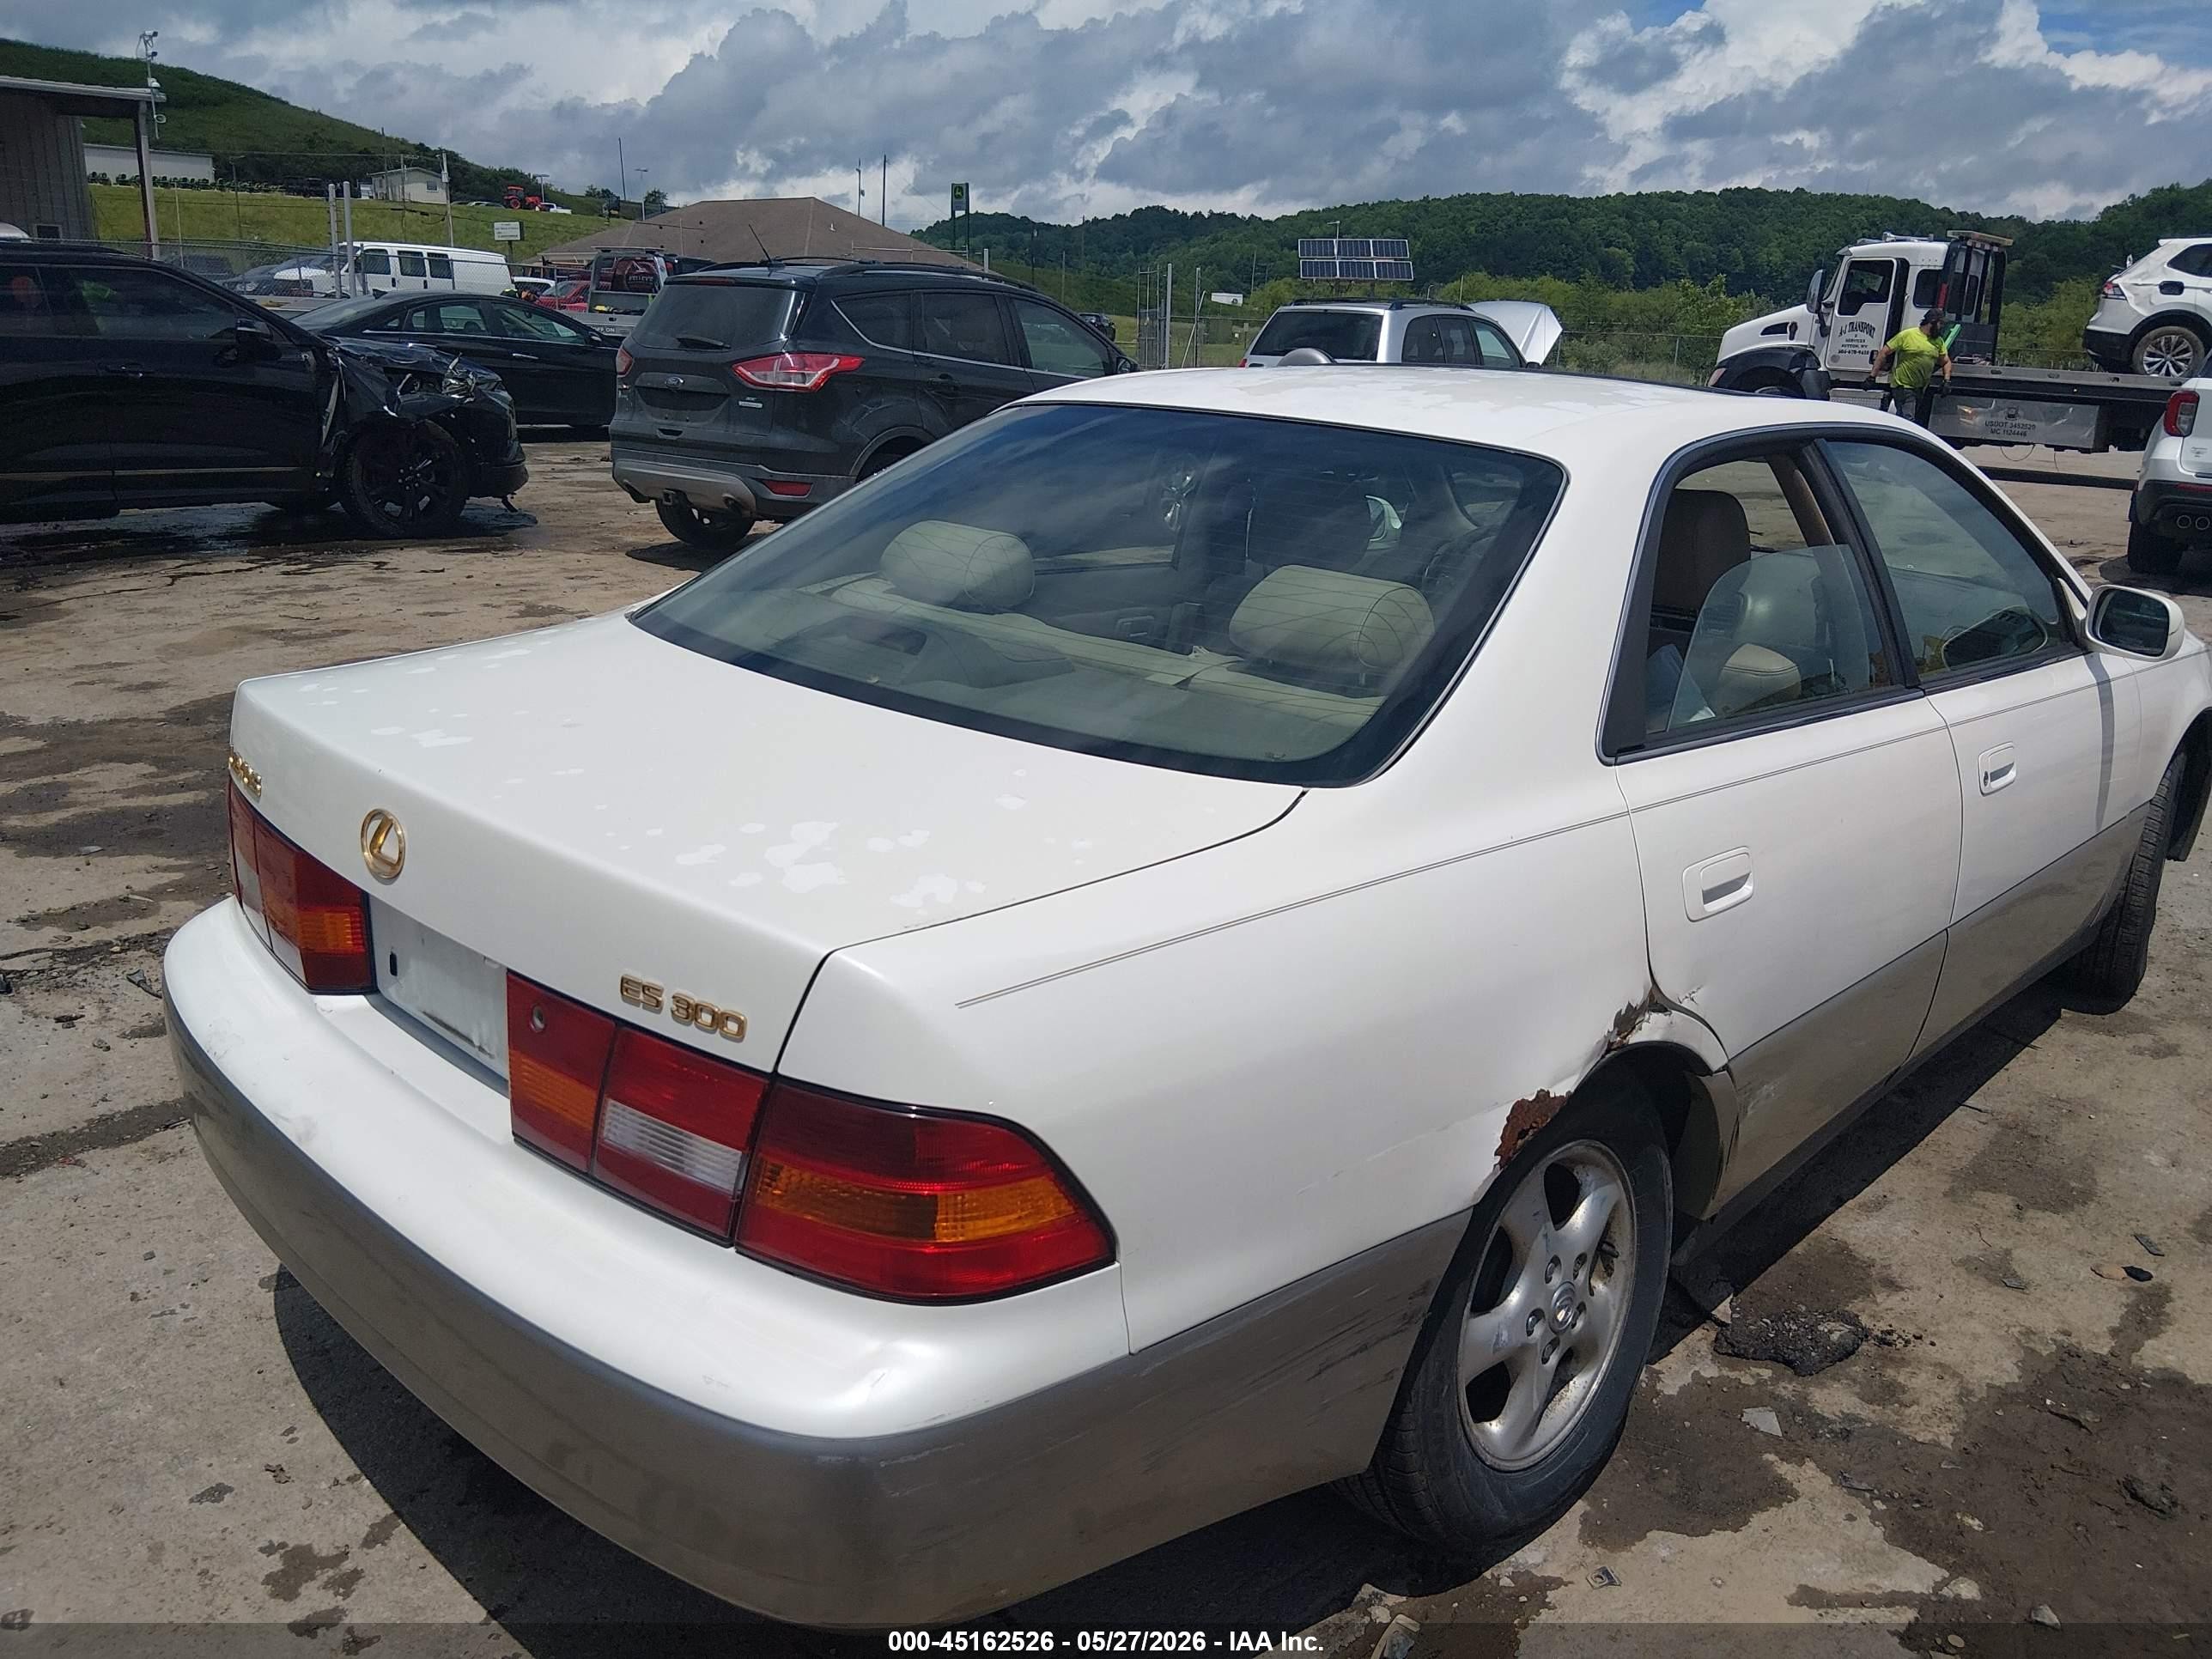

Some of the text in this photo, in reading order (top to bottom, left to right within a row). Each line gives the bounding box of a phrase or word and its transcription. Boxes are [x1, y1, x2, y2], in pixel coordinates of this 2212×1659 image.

[1848, 321, 1876, 338] TRANSPORT
[1984, 420, 2009, 428] USDOT
[620, 974, 747, 1040] ES 300
